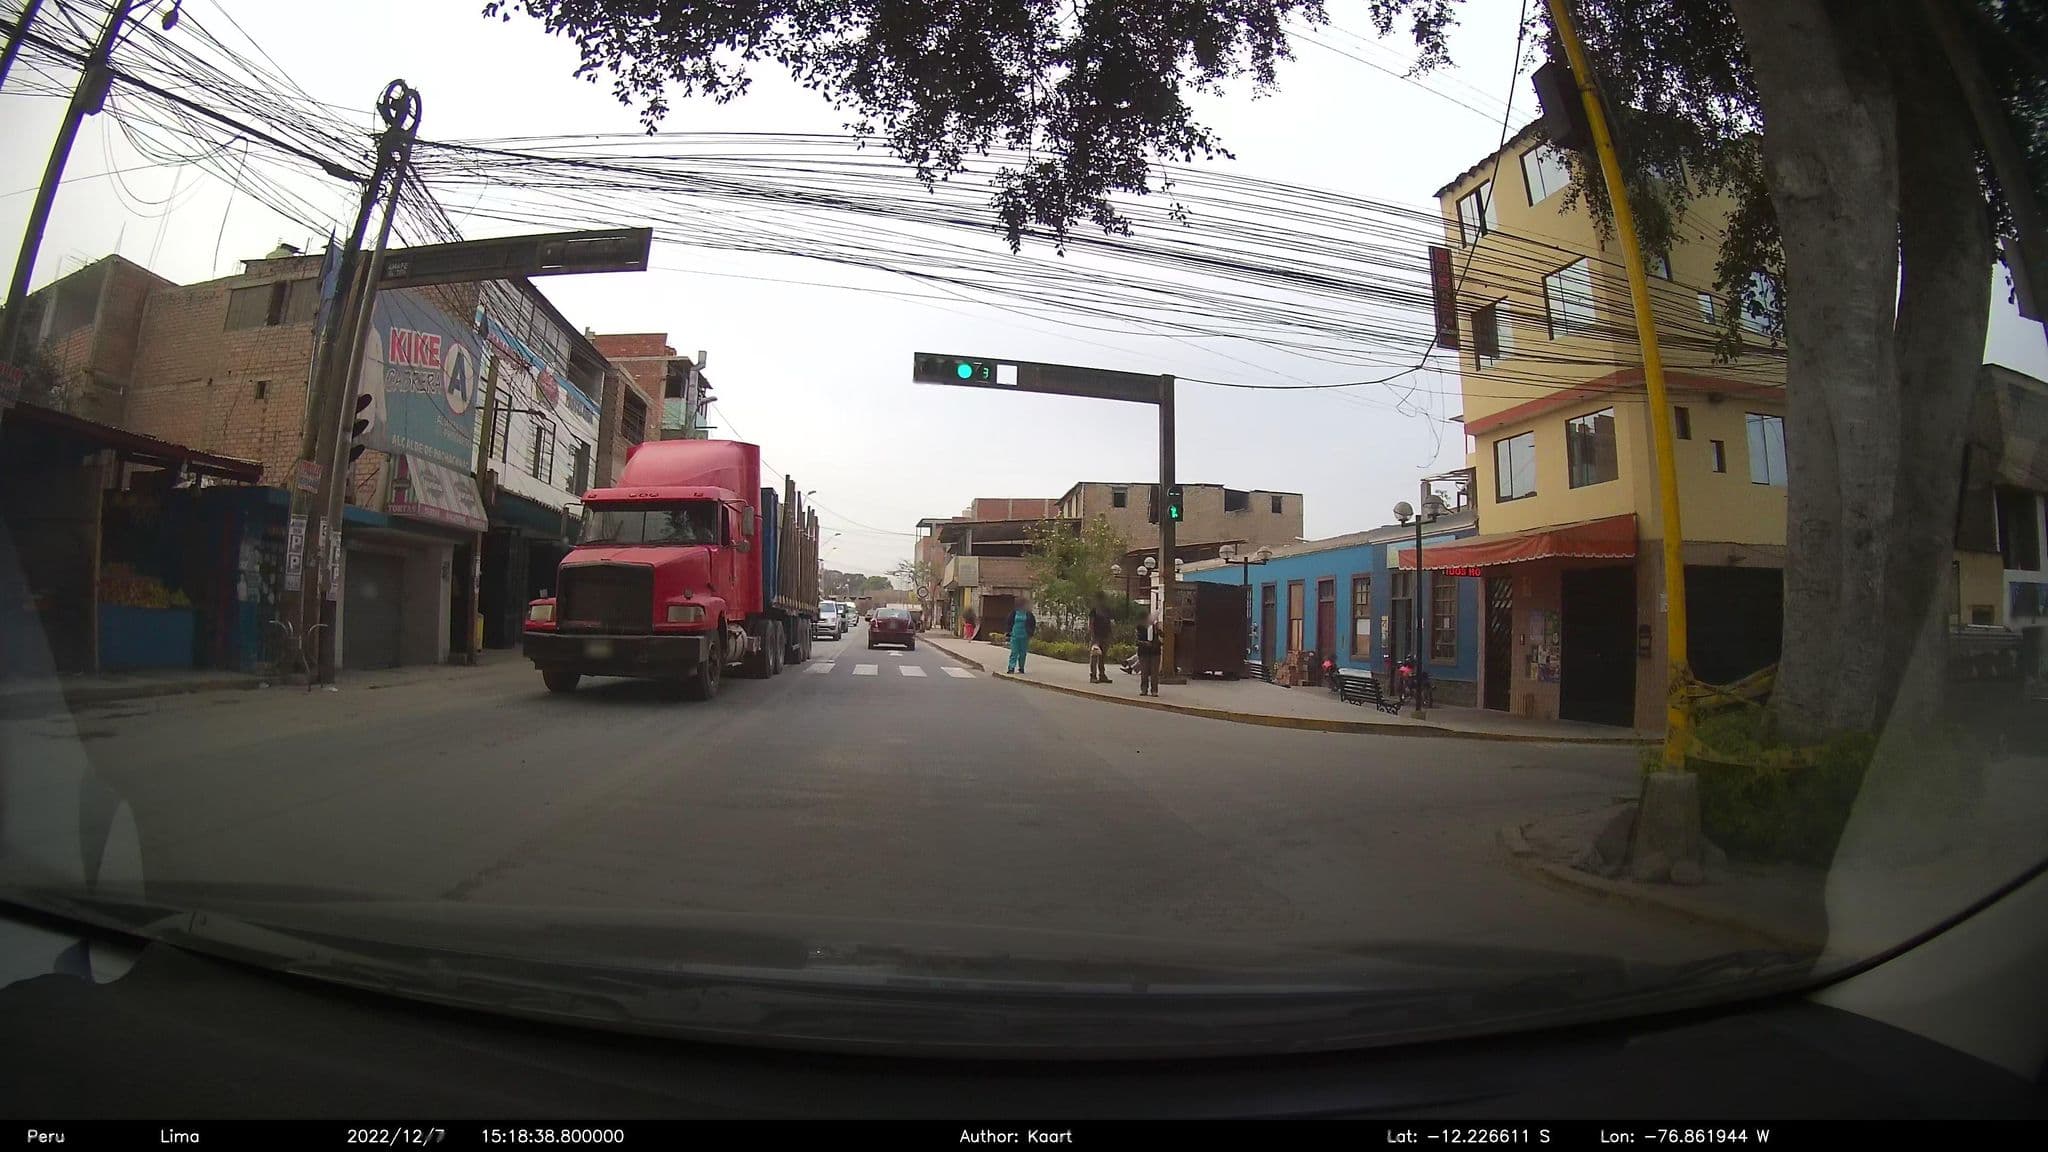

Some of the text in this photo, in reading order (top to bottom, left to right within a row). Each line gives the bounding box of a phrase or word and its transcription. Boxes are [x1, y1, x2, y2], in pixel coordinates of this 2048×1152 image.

[390, 328, 441, 368] KIKE
[448, 352, 467, 402] A
[982, 367, 990, 379] 3
[392, 434, 424, 453] ALCALDE
[388, 504, 416, 513] TORTAS
